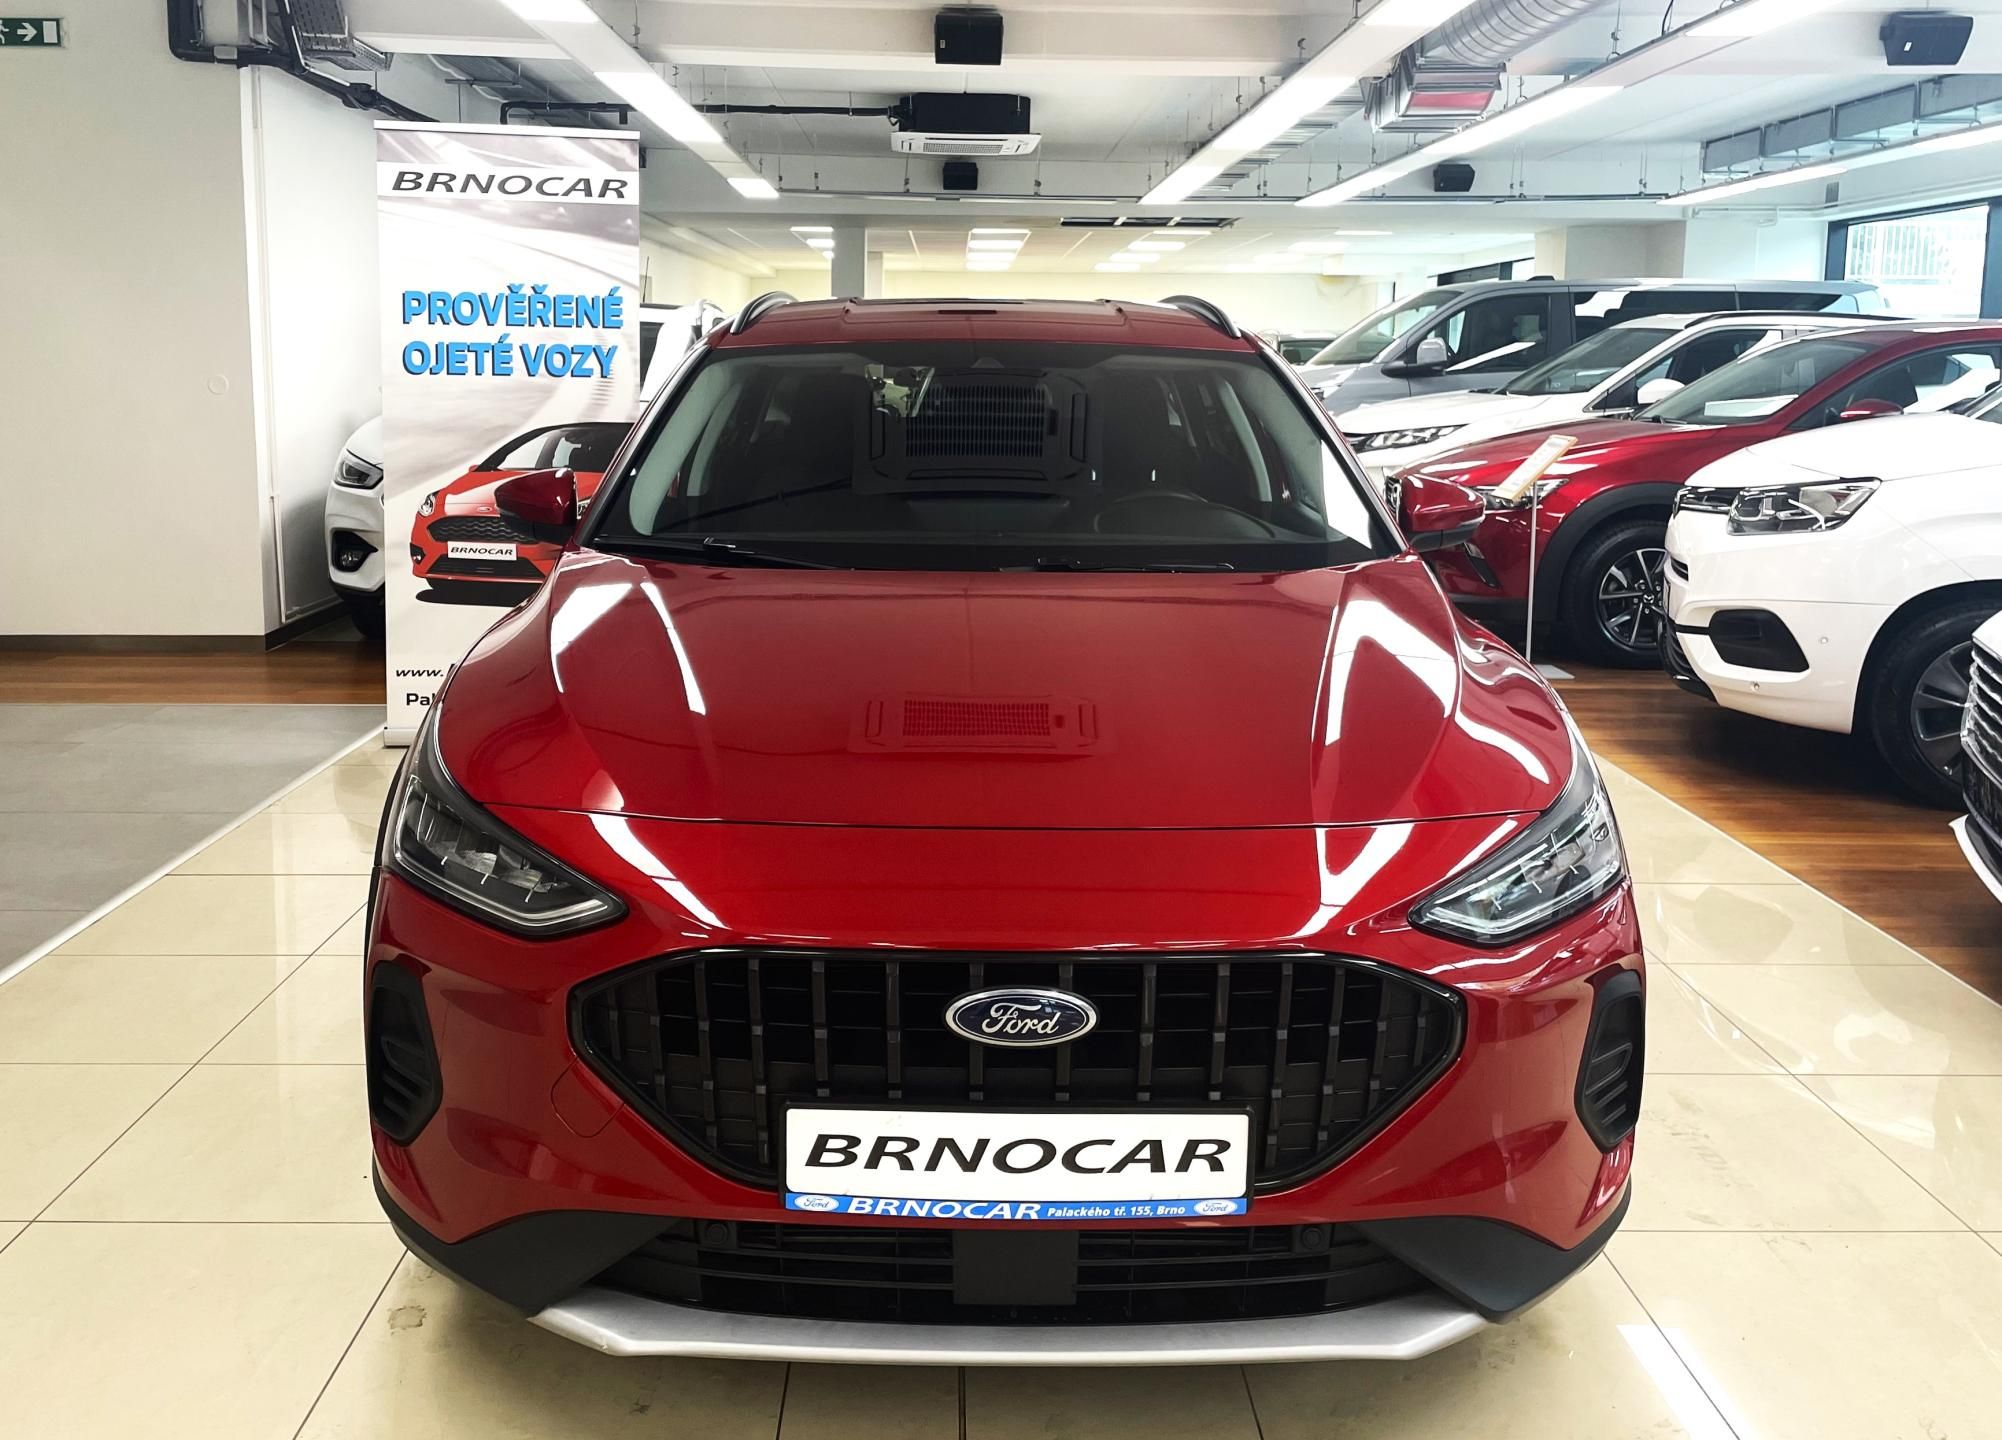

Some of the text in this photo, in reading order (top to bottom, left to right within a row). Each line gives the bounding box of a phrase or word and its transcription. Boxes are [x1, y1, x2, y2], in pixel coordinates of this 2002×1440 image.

[392, 171, 628, 198] BRNOCAR
[402, 284, 624, 328] PROVĚŘENÉ
[402, 333, 618, 378] OJETÉ VOZY
[450, 546, 514, 556] BRNOCAR
[981, 1002, 1061, 1034] Ford
[804, 1133, 1232, 1175] BRNOCAR
[803, 1198, 829, 1209] Ford
[847, 1198, 1041, 1220] BRNOCAR
[1047, 1205, 1186, 1217] Palackého tř. 155, Brno
